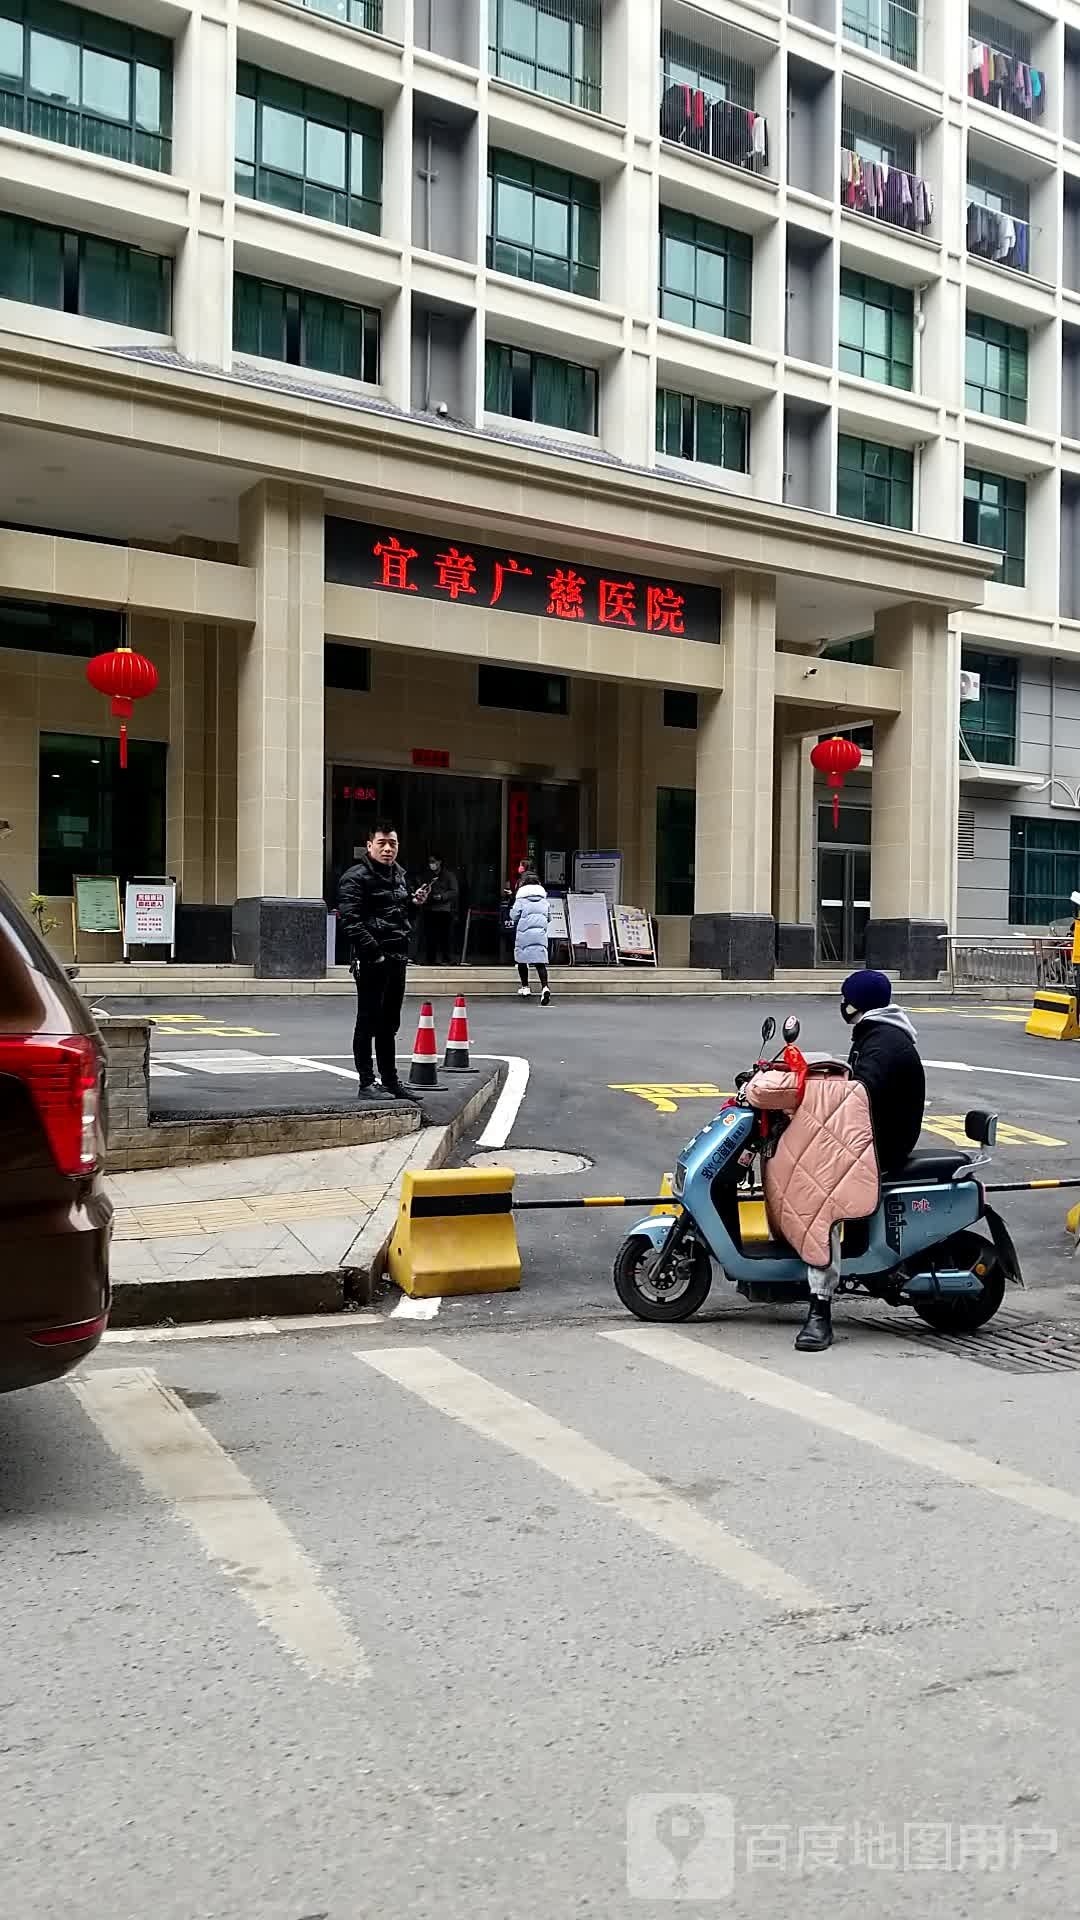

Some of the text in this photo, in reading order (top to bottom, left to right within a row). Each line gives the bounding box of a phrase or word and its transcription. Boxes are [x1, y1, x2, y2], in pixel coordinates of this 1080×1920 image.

[373, 537, 686, 634] 宜章广慈医院
